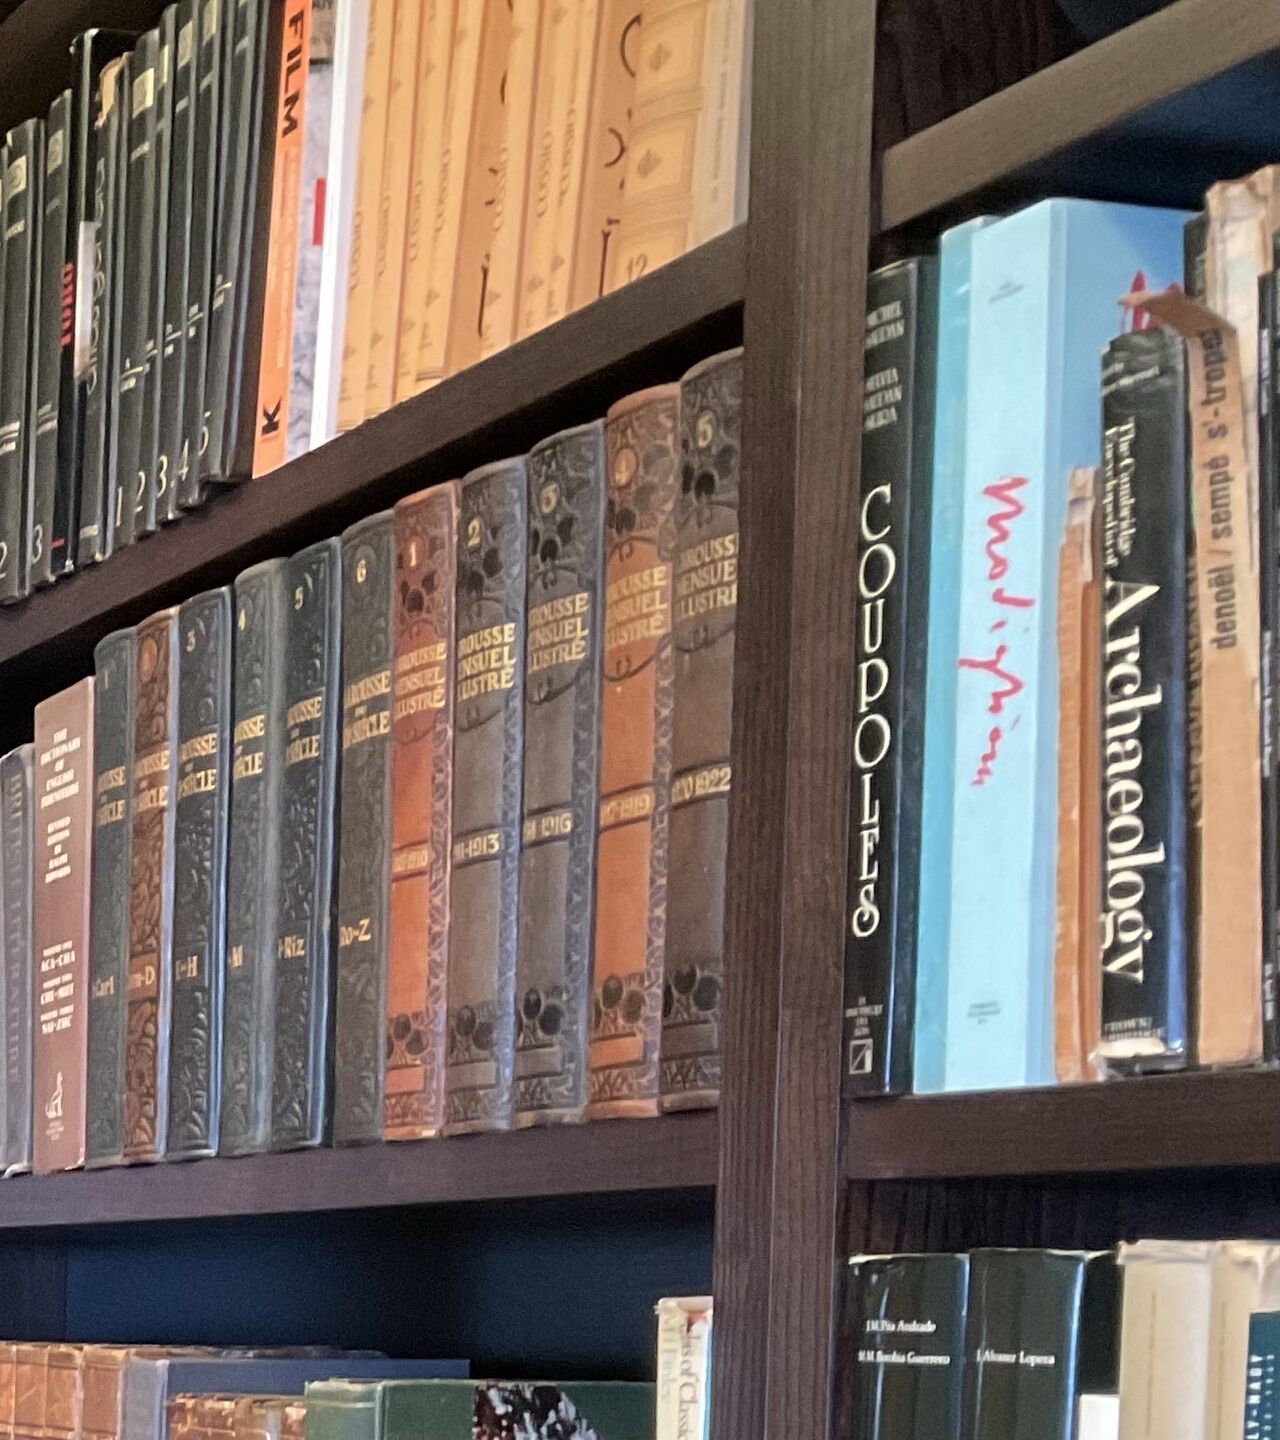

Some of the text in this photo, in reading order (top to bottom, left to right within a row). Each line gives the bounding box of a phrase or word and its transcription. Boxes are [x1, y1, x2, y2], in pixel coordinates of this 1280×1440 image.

[281, 8, 304, 138] FILM
[695, 417, 714, 450] 5
[156, 455, 168, 498] 3
[178, 438, 190, 481] 4
[133, 471, 146, 513] 2
[1209, 452, 1235, 541] sempé
[467, 518, 482, 547] 2
[356, 559, 368, 584] 6
[408, 543, 417, 568] 1
[1211, 567, 1240, 652] denoël
[851, 482, 896, 938] COUPOLES
[1103, 576, 1167, 984] Archaeology
